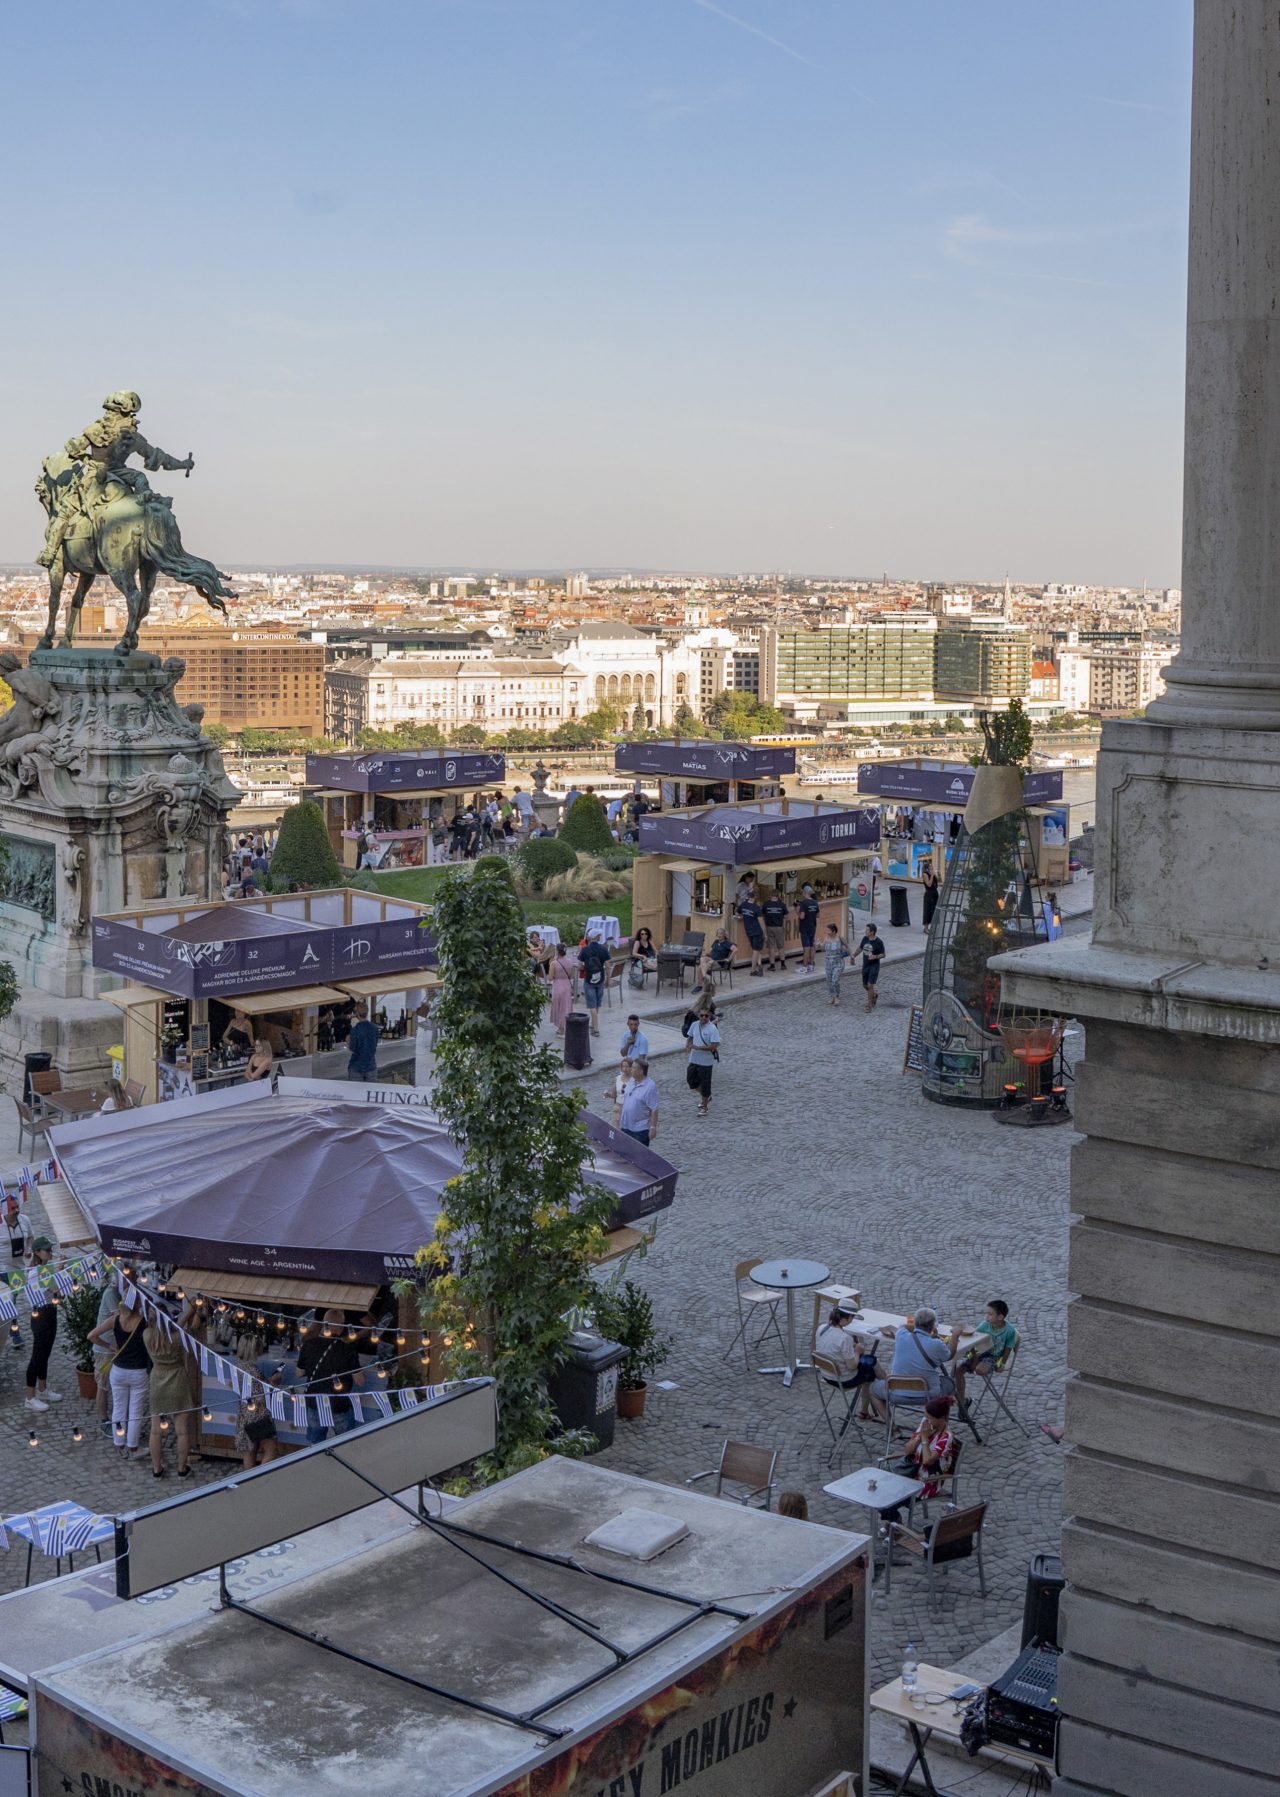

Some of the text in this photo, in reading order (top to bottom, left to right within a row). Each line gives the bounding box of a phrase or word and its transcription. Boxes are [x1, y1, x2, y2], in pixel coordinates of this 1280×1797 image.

[240, 633, 297, 641] INTERCONTINENTAL
[831, 823, 856, 838] TORNAI
[405, 930, 413, 938] 31
[137, 942, 145, 951] 32
[248, 950, 259, 960] 32
[213, 965, 286, 980] ADRIENNE DELUXE PRÉMIUM
[202, 979, 224, 988] MAGYAR
[224, 978, 236, 986] BOR
[236, 975, 244, 984] ÉS
[264, 1247, 278, 1256] 34
[229, 1257, 249, 1265] WINE
[660, 1691, 776, 1796] MONKIES
